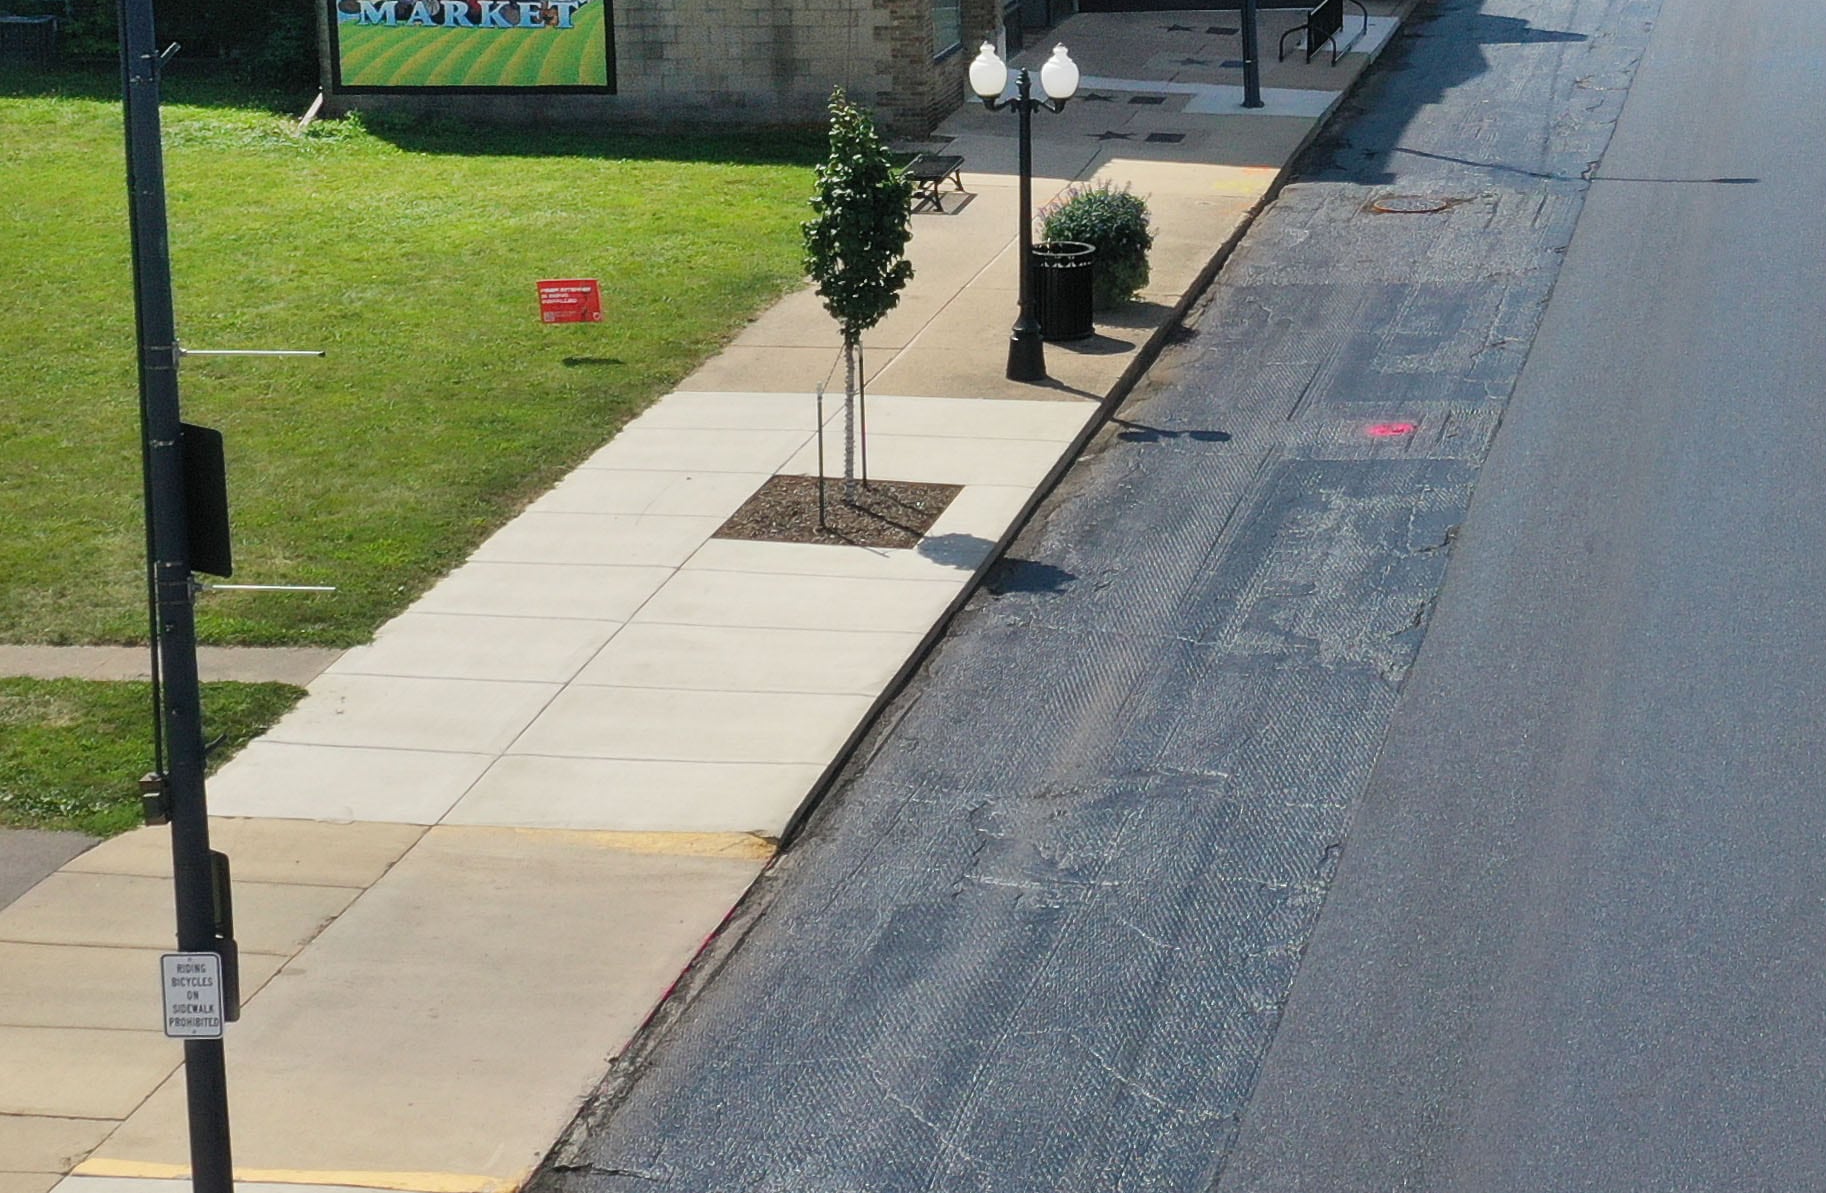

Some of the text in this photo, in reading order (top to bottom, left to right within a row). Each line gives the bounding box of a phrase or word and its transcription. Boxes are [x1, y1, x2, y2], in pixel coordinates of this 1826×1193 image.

[357, 0, 579, 29] MARKET
[176, 964, 206, 974] RIDING
[171, 977, 213, 987] BICYCLES
[187, 991, 199, 1000] ON
[172, 1004, 214, 1014] SIDEWALK
[169, 1017, 219, 1028] PROHIBITED
